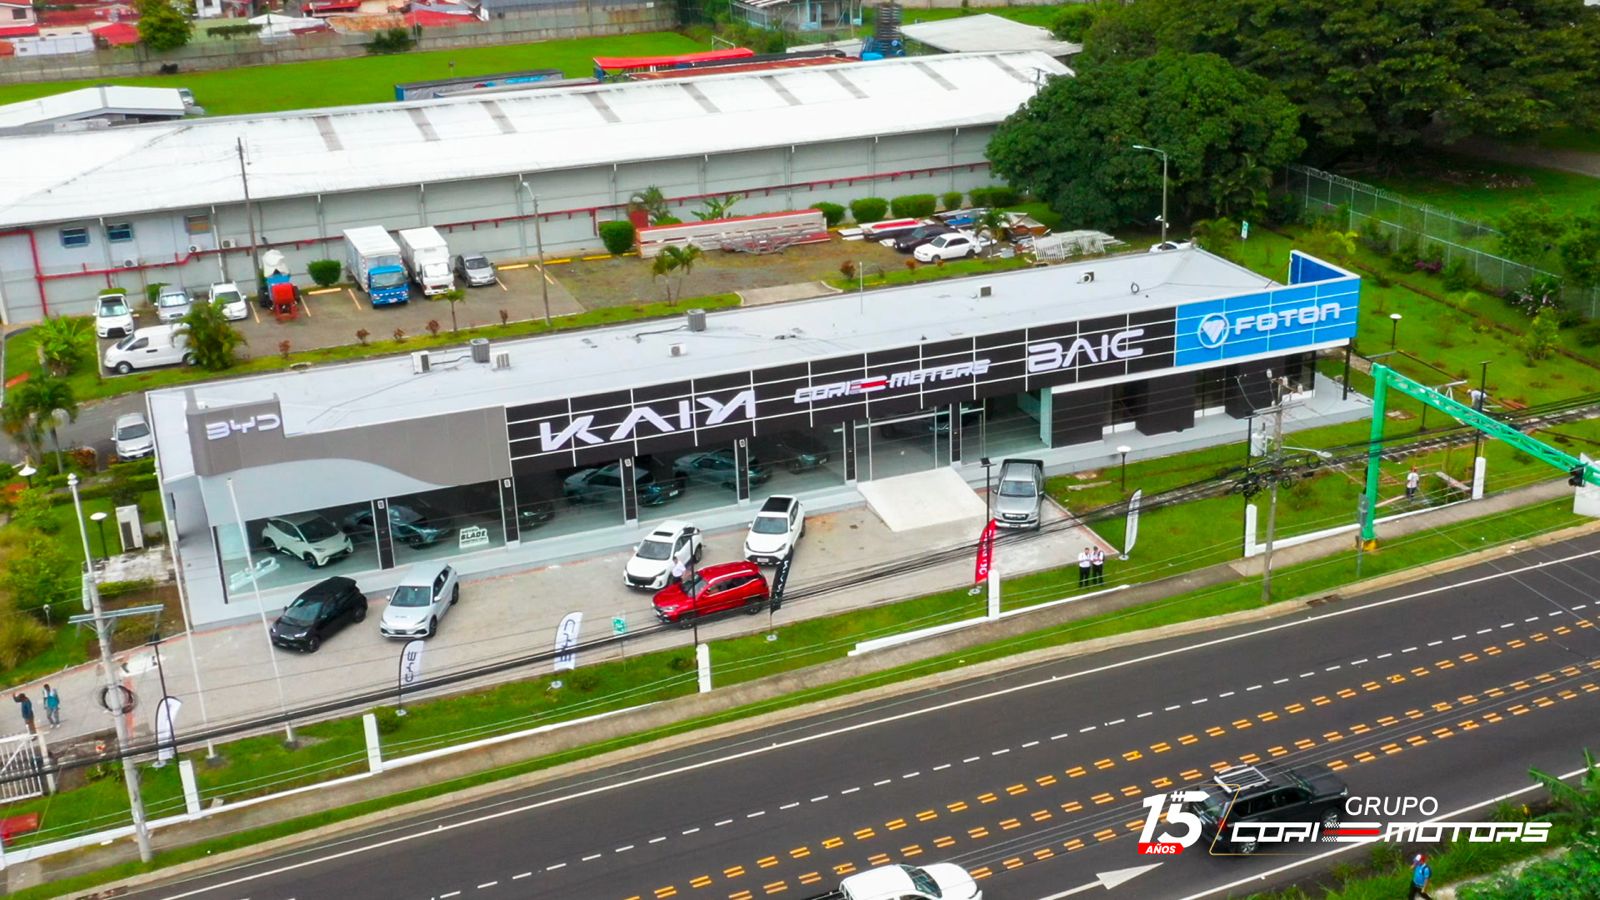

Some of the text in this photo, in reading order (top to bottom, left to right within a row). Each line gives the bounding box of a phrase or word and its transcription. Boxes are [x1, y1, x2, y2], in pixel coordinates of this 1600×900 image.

[1234, 302, 1341, 335] FOTON
[1028, 328, 1145, 373] BAIC
[205, 413, 281, 440] BYD
